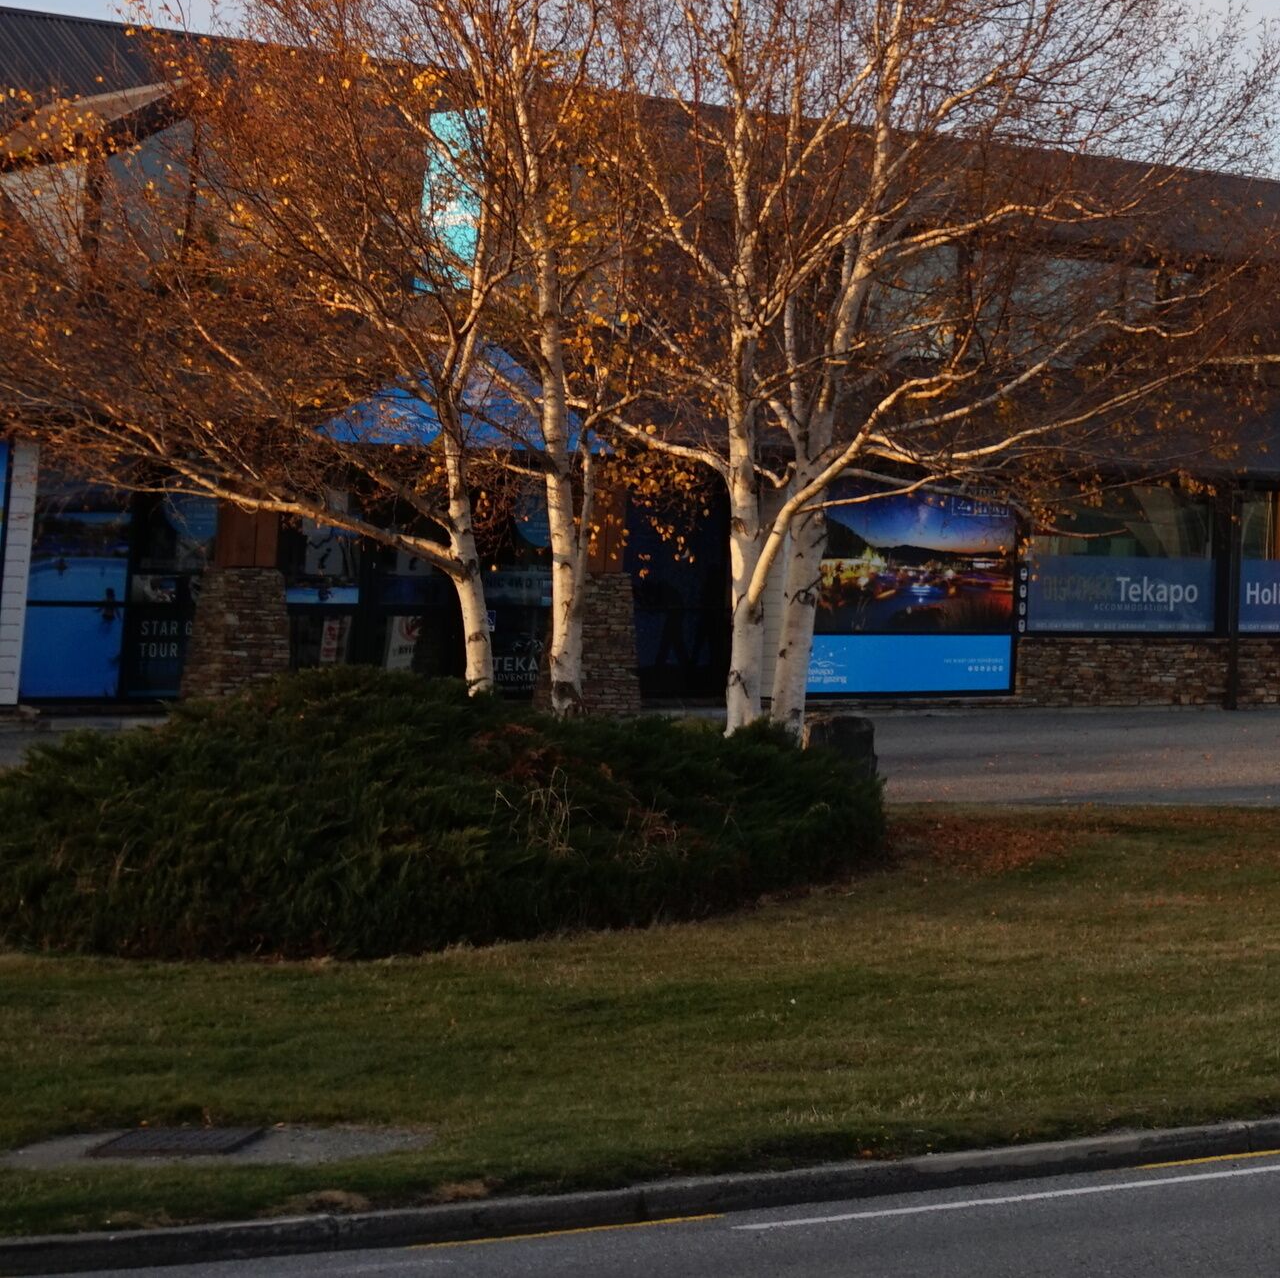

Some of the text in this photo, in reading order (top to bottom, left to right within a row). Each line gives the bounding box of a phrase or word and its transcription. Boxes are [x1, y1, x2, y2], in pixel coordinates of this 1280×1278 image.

[1116, 576, 1198, 611] Tekapo
[141, 620, 178, 636] STAR
[138, 642, 178, 658] TOUR
[493, 657, 539, 672] TEKA
